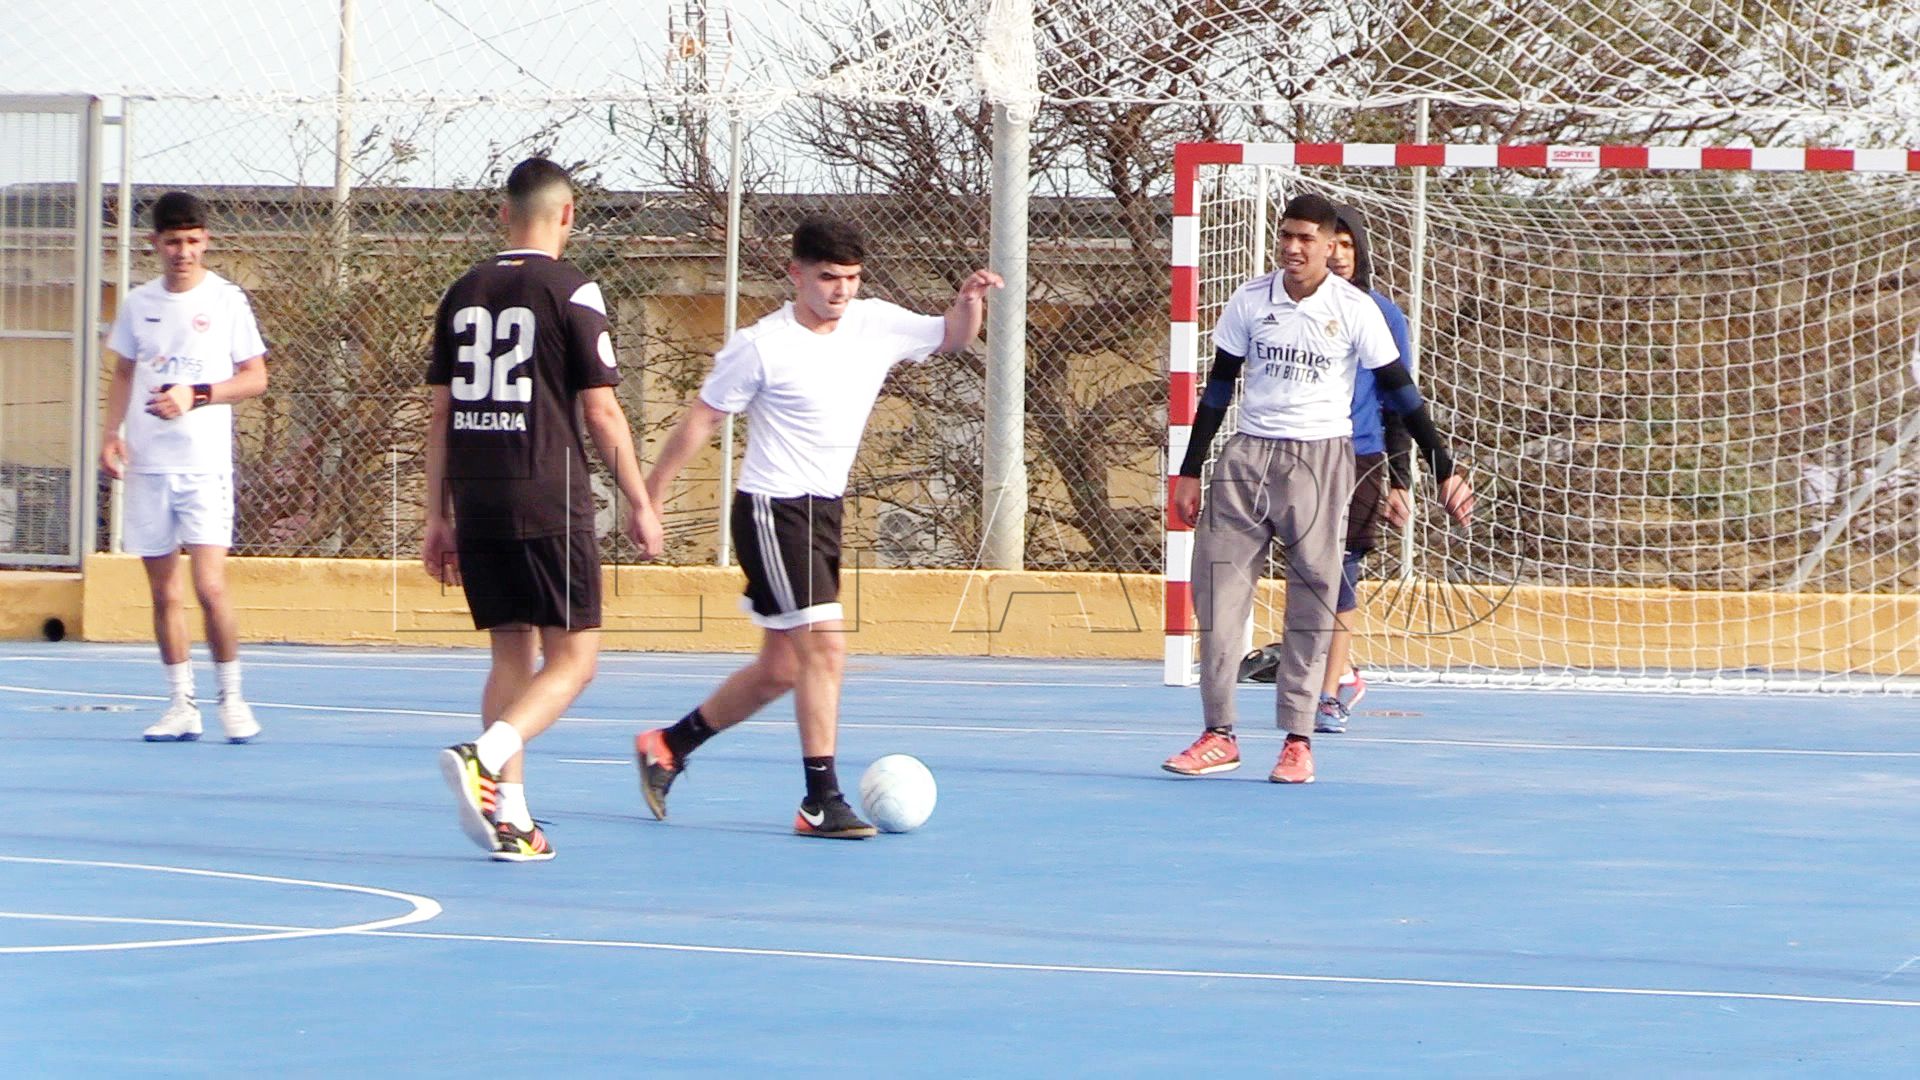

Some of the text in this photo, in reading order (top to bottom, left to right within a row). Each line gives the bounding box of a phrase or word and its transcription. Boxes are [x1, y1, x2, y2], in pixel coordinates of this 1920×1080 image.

[451, 306, 536, 403] 32
[1255, 341, 1332, 370] Emirates
[1264, 362, 1320, 385] FLY BETTER
[453, 410, 527, 431] BALEARIA
